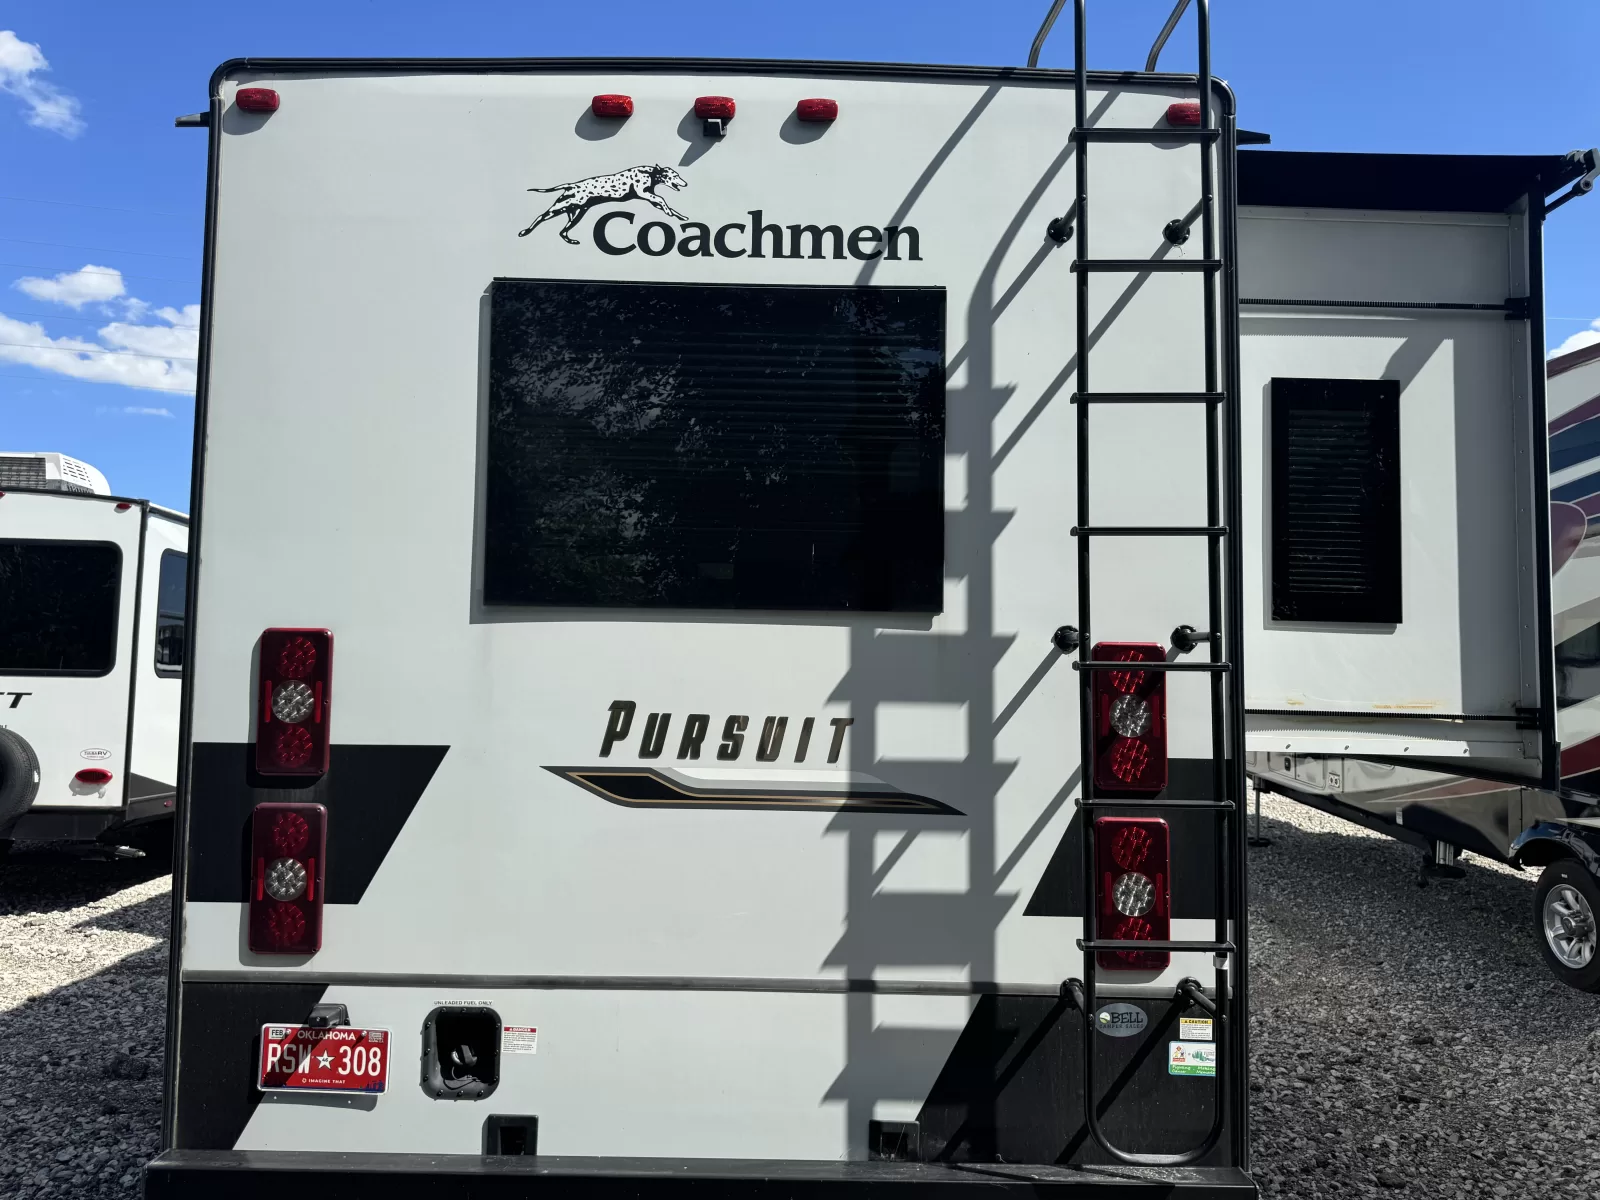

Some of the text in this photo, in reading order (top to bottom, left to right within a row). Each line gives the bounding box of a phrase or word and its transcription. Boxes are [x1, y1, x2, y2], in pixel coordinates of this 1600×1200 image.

[593, 209, 923, 261] Coachmen
[0, 692, 33, 708] T
[599, 700, 855, 764] PURSUIT
[1110, 1012, 1144, 1023] BELL
[297, 1030, 356, 1041] OKLAHOMA
[267, 1043, 382, 1077] RSW 308
